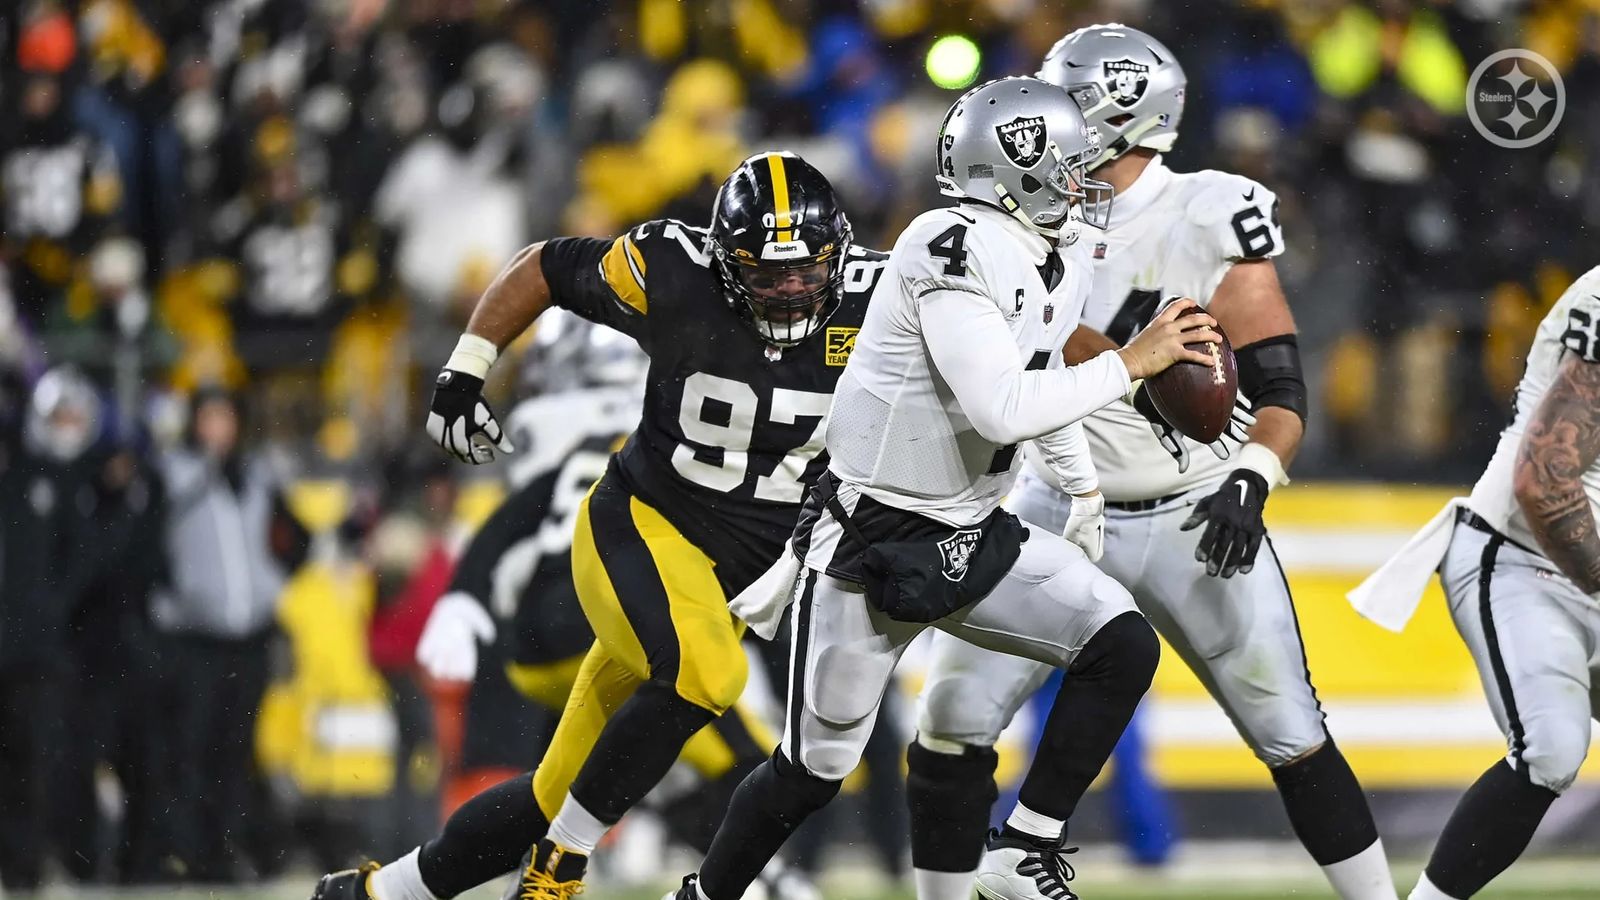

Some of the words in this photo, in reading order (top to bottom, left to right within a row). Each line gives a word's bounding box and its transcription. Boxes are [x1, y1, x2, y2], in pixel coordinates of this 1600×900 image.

[1000, 117, 1045, 134] RAIDERS
[944, 156, 956, 177] 4
[773, 245, 798, 253] Steelers
[927, 223, 969, 277] 4
[1015, 288, 1025, 312] C
[1560, 308, 1600, 363] 6
[828, 355, 849, 364] YEAR
[671, 371, 835, 503] 97
